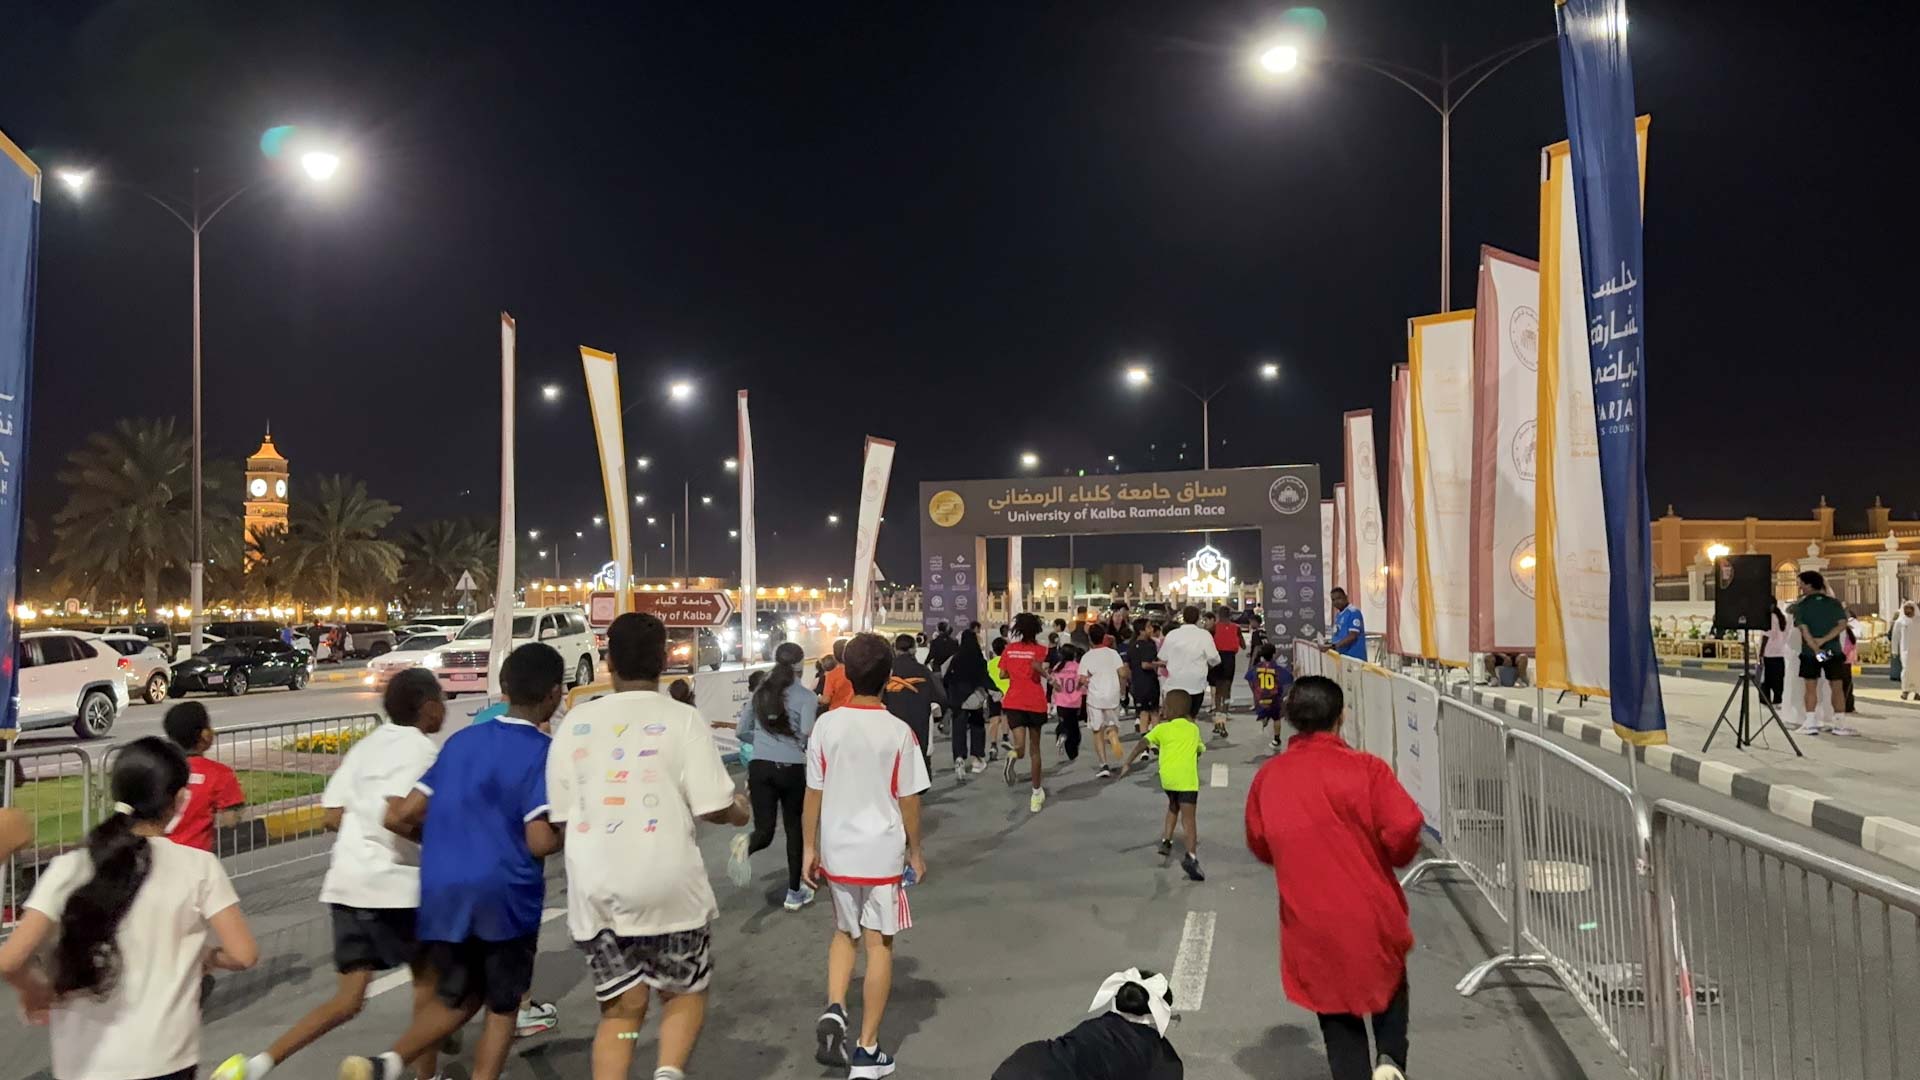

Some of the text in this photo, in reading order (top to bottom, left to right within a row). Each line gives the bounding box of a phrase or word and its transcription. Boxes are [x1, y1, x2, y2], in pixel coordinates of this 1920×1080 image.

[1597, 398, 1634, 422] ARJA
[988, 485, 1063, 515] الرمضاني
[1068, 484, 1112, 507] كلباء
[1117, 482, 1171, 505] جامعة
[1176, 480, 1228, 503] سباق
[1007, 503, 1226, 524] University of Kalba Ramadan Race
[655, 596, 712, 607] جامعة كلباء
[669, 610, 681, 621] of
[682, 610, 712, 621] Kalba
[1258, 672, 1275, 690] 10
